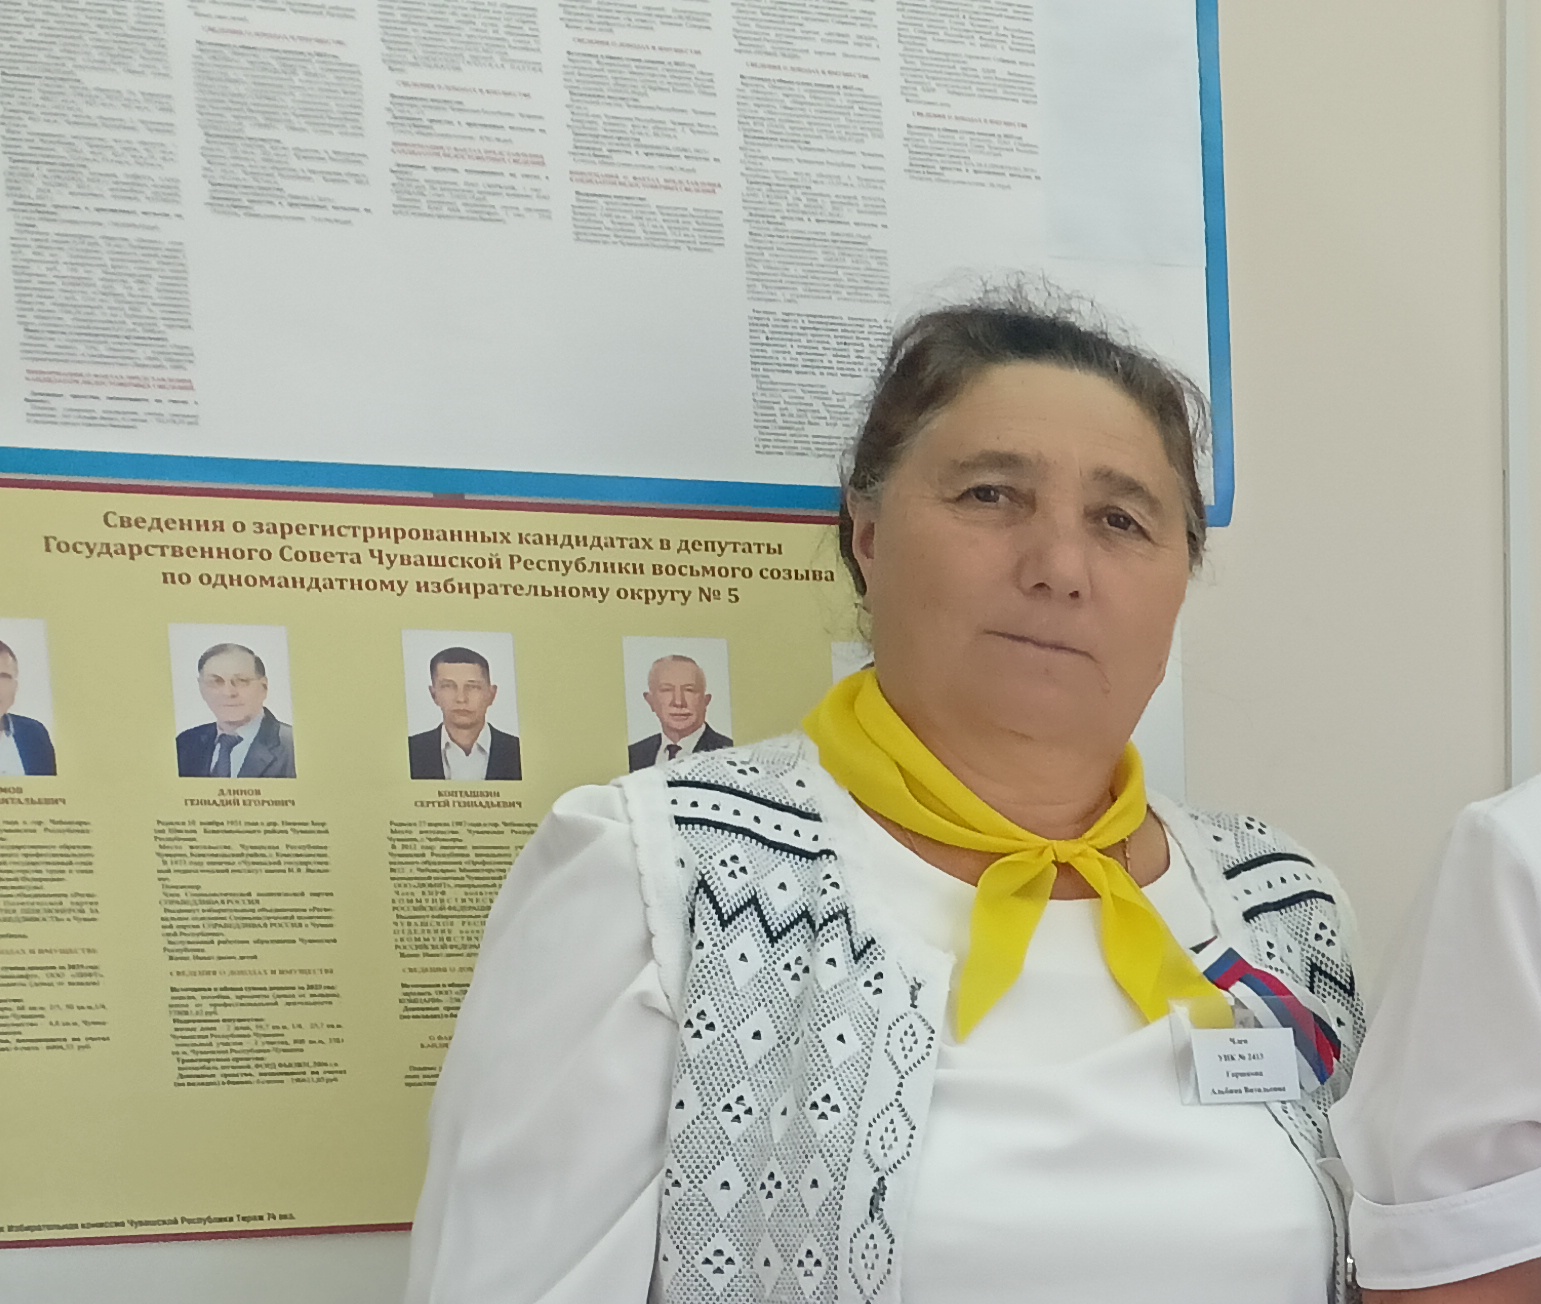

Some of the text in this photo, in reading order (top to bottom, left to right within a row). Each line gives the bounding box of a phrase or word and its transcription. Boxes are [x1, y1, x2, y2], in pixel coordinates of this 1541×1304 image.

[103, 511, 783, 557] Сведения о зарегистрированных кандидатах в депутаты
[43, 535, 835, 583] Государственного Совета Чувашской Республики восьмого созыва
[161, 570, 740, 606] по одномандатному избирательному округу № 5
